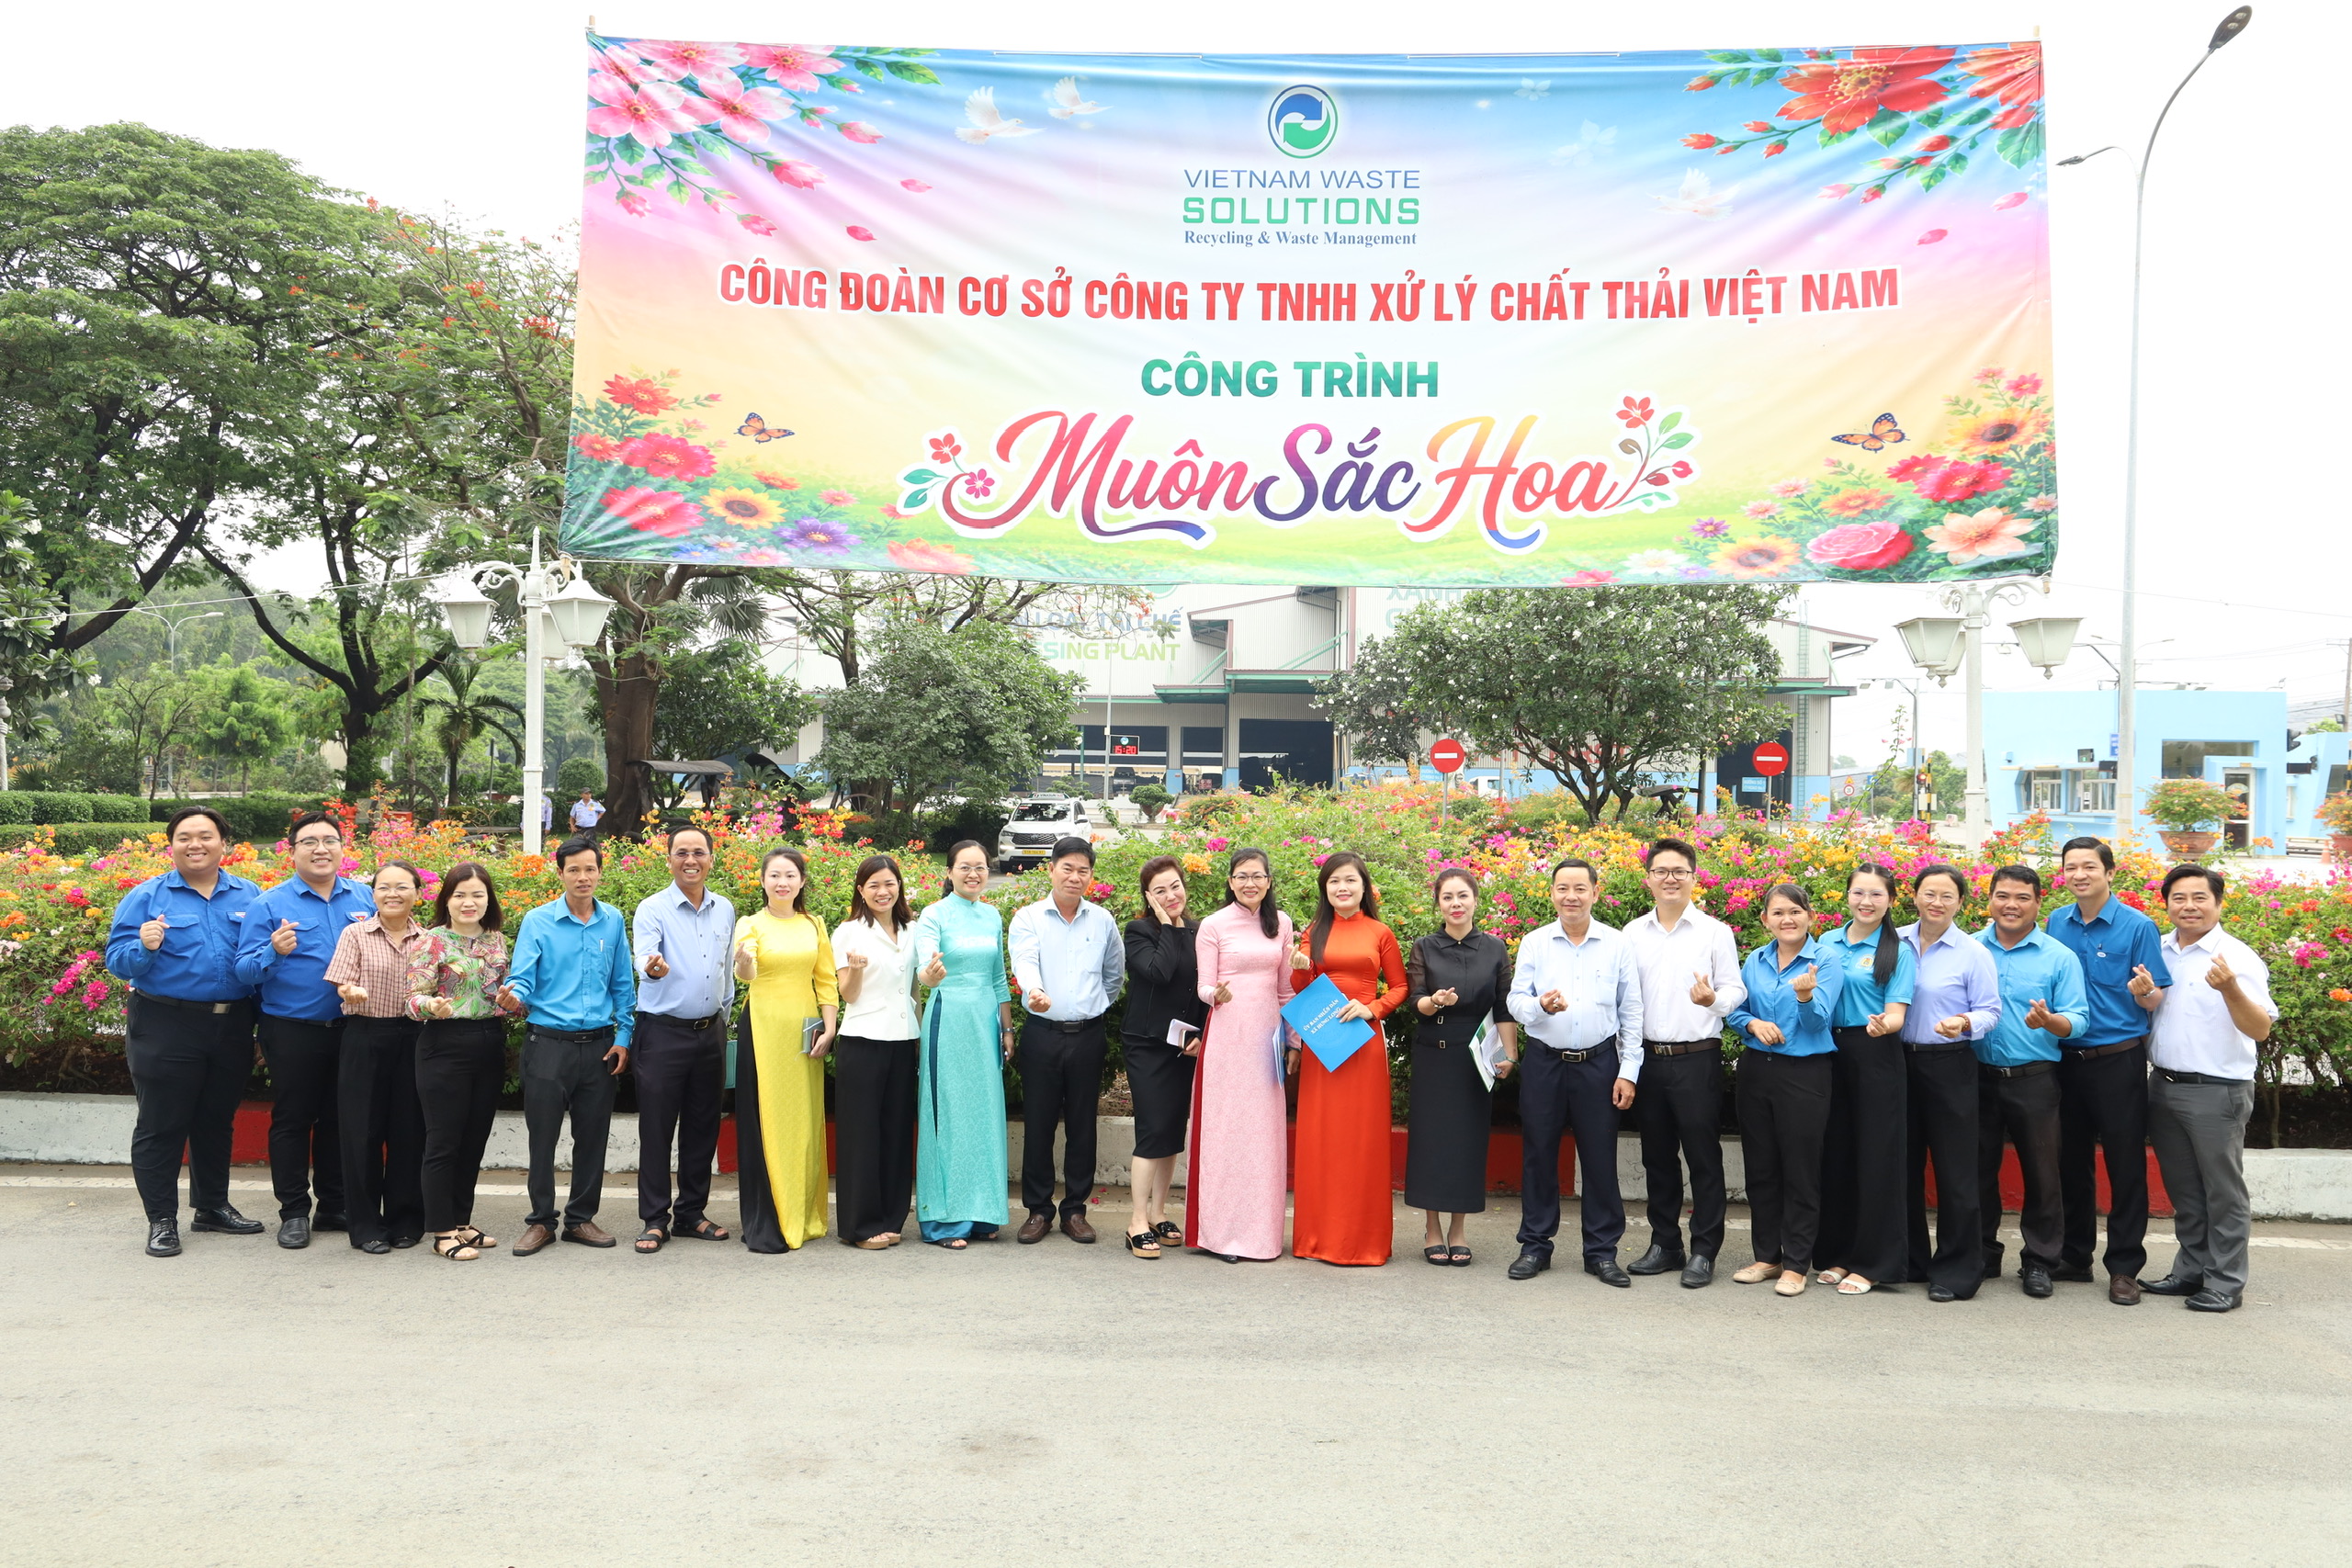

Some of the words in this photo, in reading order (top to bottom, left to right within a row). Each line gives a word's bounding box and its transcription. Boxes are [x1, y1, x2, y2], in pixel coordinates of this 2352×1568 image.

[1183, 169, 1310, 189] VIETNAM
[1319, 170, 1420, 189] WASTE
[1182, 197, 1419, 225] SOLUTIONS
[1184, 230, 1253, 248] Recycling
[1257, 231, 1271, 245] &
[1275, 231, 1318, 245] Waste
[1323, 231, 1417, 248] Management
[719, 258, 827, 310] CÔNG
[840, 267, 944, 314] ĐOÀN
[958, 275, 1010, 317] CƠ
[1021, 266, 1073, 318] SỞ
[1084, 273, 1188, 320] CÔNG
[1201, 282, 1244, 321] TY
[1257, 283, 1356, 321] TNHH
[1369, 269, 1425, 321] XỬ
[1434, 267, 1478, 321] LÝ
[1490, 267, 1590, 321] CHẤT
[1602, 266, 1690, 319] THẢI
[1703, 269, 1787, 324] VIỆT
[1801, 268, 1899, 313] NAM
[1141, 351, 1278, 398] CÔNG
[1294, 352, 1439, 399] TRÌNH
[941, 410, 1258, 542] Muôn
[1253, 423, 1421, 522] Sắc
[1403, 413, 1622, 549] Hoa
[1105, 643, 1181, 660] PLANT
